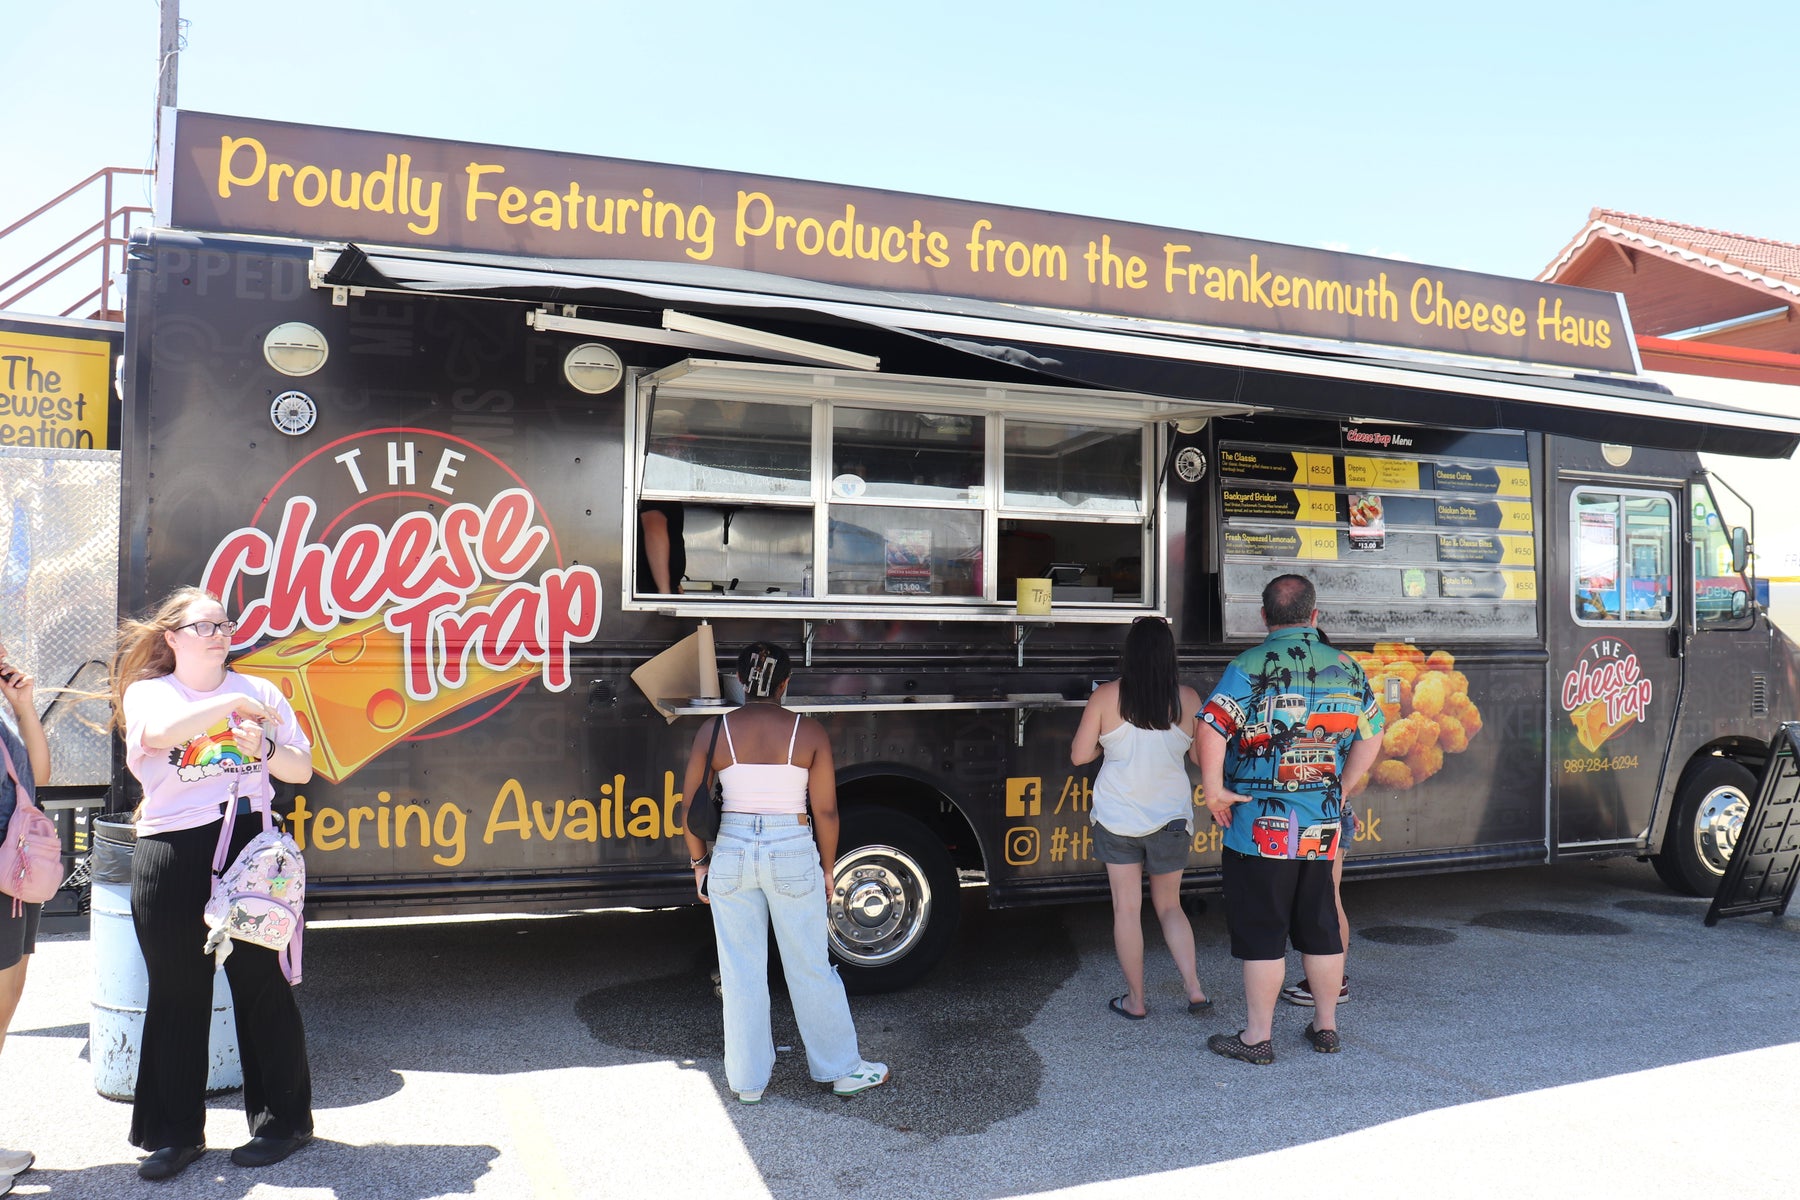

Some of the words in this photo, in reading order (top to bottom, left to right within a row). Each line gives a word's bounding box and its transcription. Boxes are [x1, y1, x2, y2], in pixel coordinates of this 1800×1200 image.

[217, 135, 443, 236] Proudly
[466, 162, 716, 261] Featuring
[735, 190, 950, 269] Products
[966, 219, 1067, 281] from
[1083, 234, 1148, 289] the
[1163, 242, 1399, 322] Frankenmuth
[1410, 277, 1527, 337] Cheese
[1537, 297, 1612, 349] Haus
[2, 355, 61, 393] The
[0, 393, 87, 421] ewest
[0, 420, 93, 449] eation
[1347, 429, 1374, 443] Cheese
[1374, 433, 1391, 447] Trap
[1391, 434, 1413, 446] Menu
[1221, 451, 1233, 460] The
[1234, 452, 1257, 463] Classic
[334, 442, 466, 494] THE
[1311, 465, 1331, 475] $8.50
[1348, 464, 1366, 474] Dipping
[1436, 470, 1456, 480] Cheese
[1456, 471, 1472, 481] Curds
[1511, 478, 1528, 487] $9.50
[1223, 491, 1254, 502] Backyard
[1254, 492, 1277, 502] Brisket
[1311, 503, 1334, 512] $14.00
[1438, 505, 1459, 515] Chicken
[1460, 506, 1476, 517] Strips
[1513, 512, 1530, 521] $9.00
[1225, 533, 1241, 541] Fresh
[1242, 533, 1268, 544] Squeezed
[1269, 534, 1297, 544] Lemonade
[1315, 540, 1334, 549] $9.00
[1459, 538, 1478, 547] Cheese
[1514, 547, 1531, 556] $9.50
[200, 488, 550, 651] Cheese
[1516, 582, 1534, 590] $5.50
[1706, 584, 1737, 598] peps
[385, 564, 602, 701] Trap
[1590, 640, 1622, 659] THE
[1561, 654, 1640, 711] Cheese
[1603, 678, 1652, 726] Trap
[1563, 755, 1639, 773] 989-284-6294
[272, 791, 466, 866] tering
[483, 770, 686, 845] Availab
